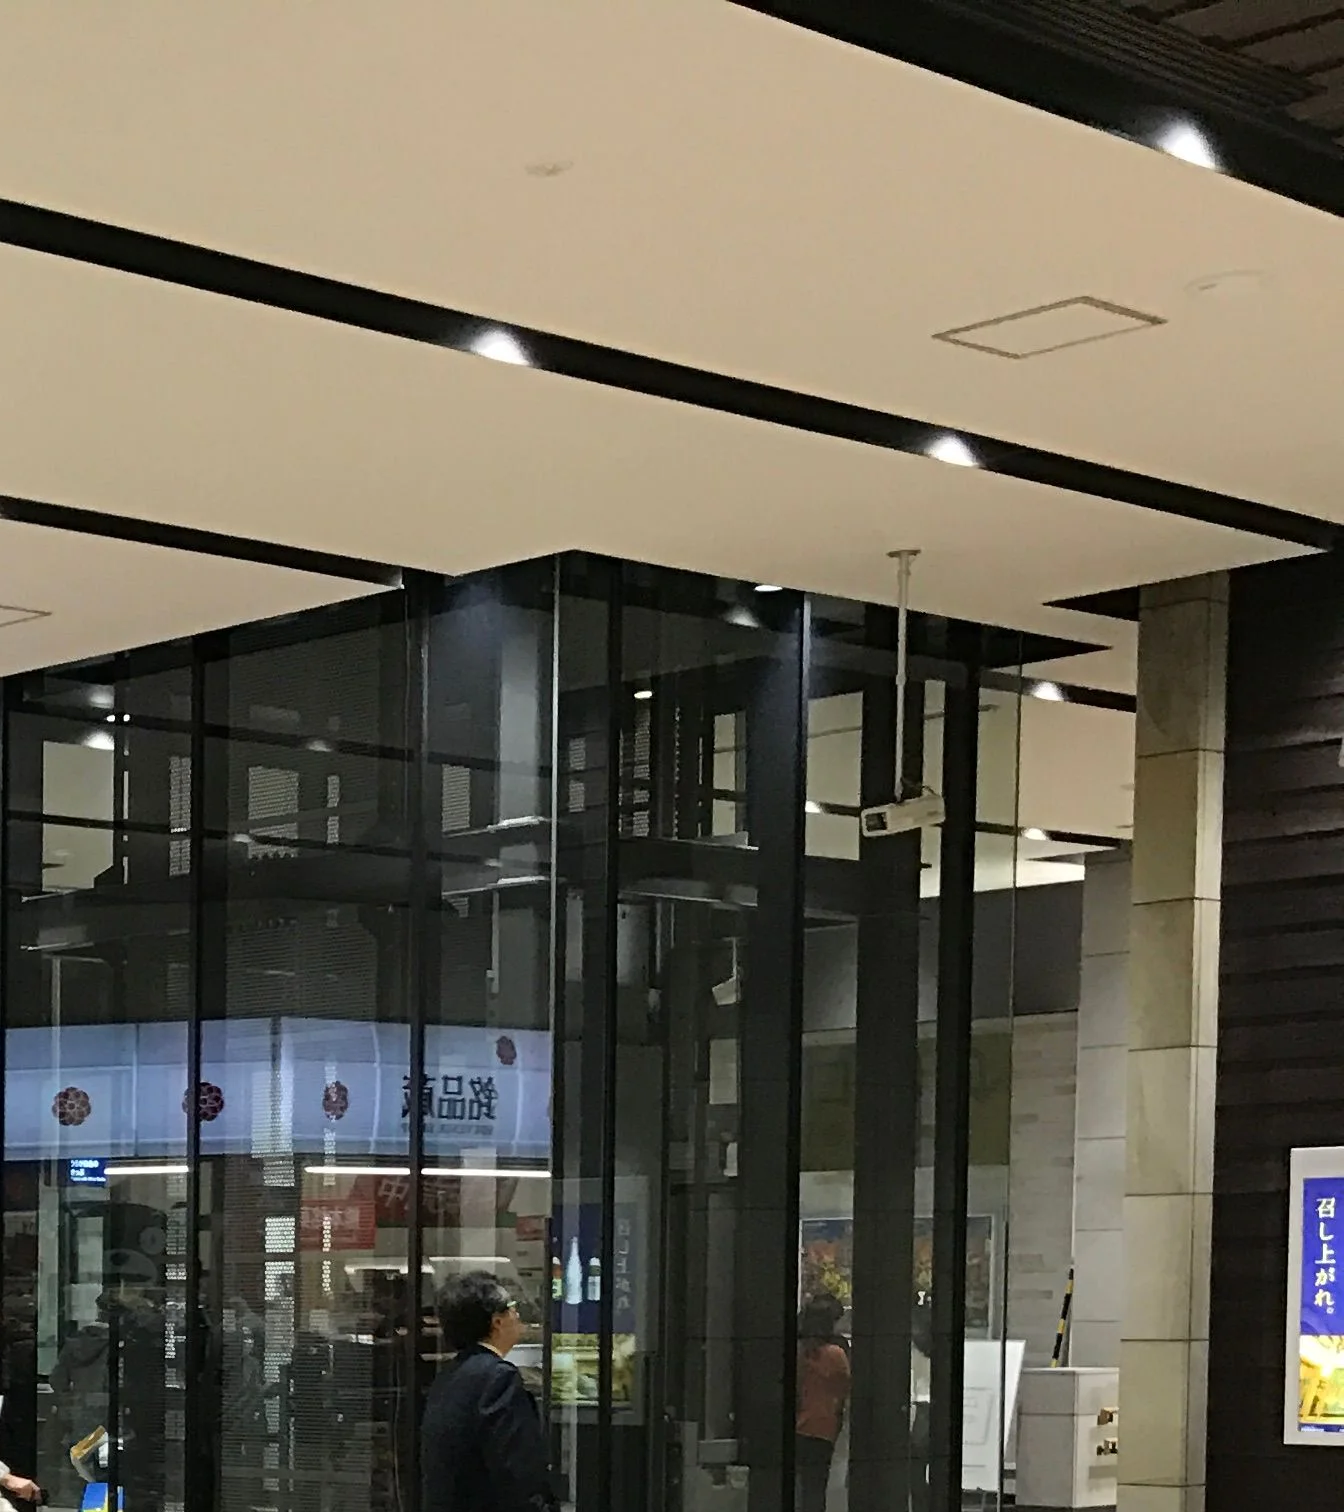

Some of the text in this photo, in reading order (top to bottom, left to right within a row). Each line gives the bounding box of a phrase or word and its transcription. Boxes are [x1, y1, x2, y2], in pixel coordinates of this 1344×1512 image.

[1314, 1197, 1336, 1314] 召し上がれ。
